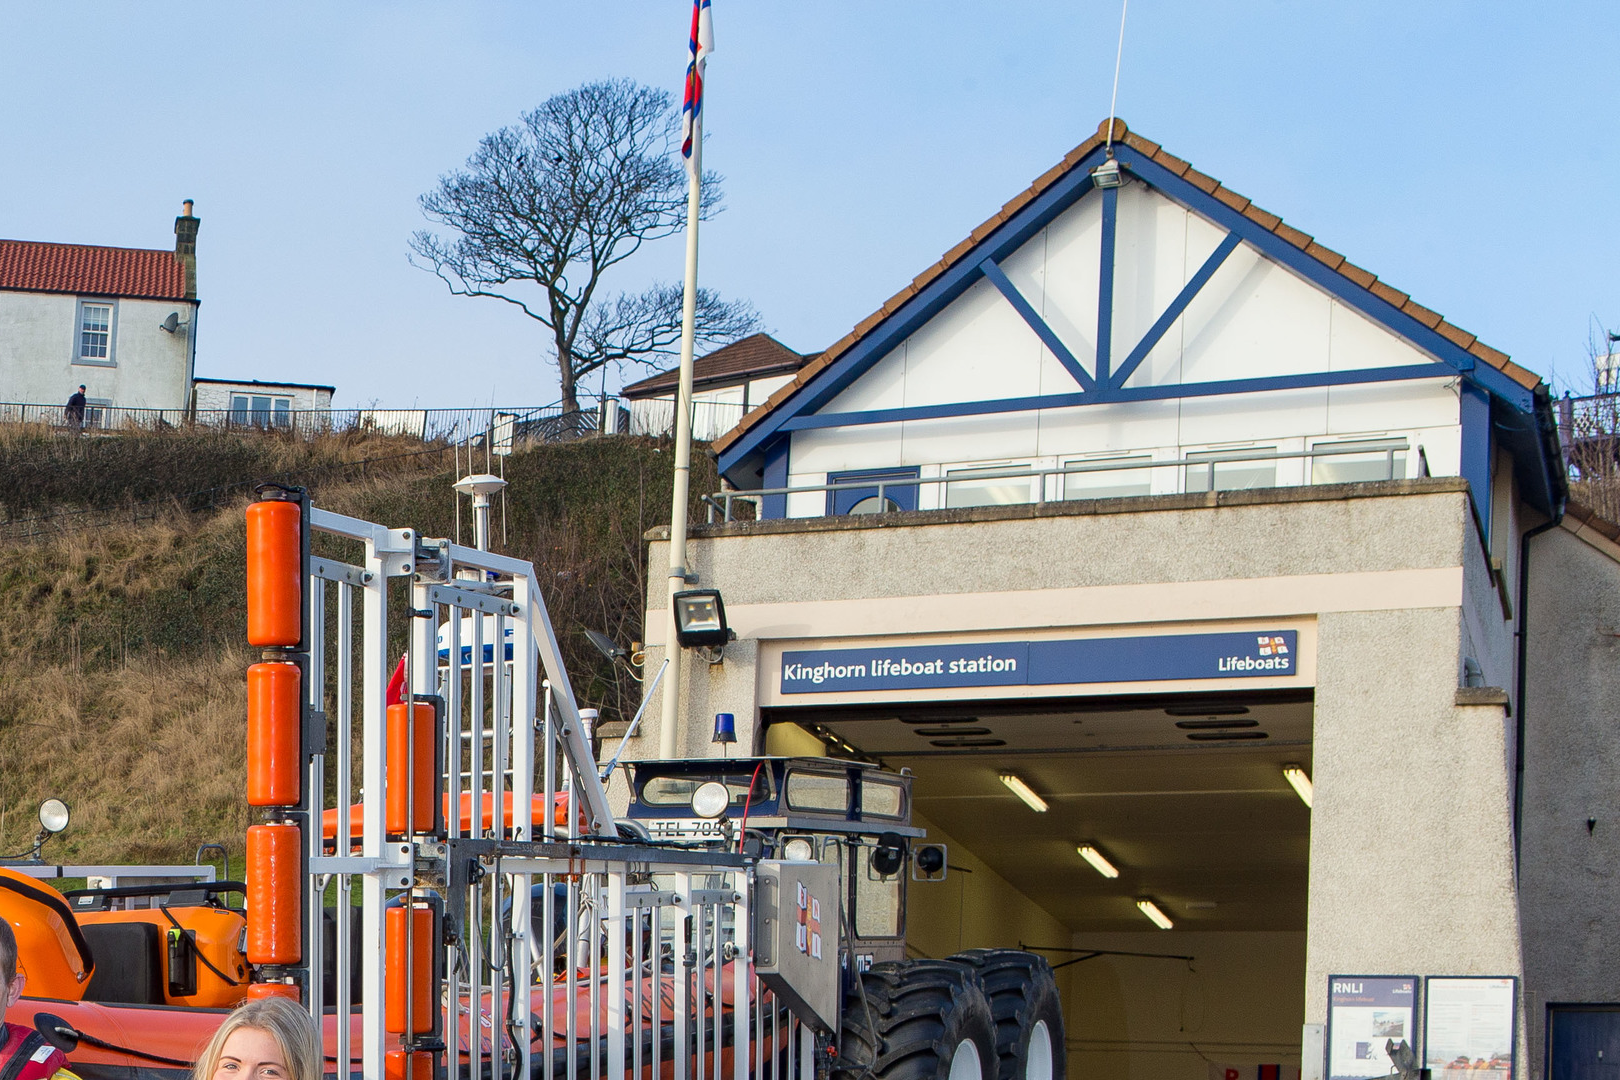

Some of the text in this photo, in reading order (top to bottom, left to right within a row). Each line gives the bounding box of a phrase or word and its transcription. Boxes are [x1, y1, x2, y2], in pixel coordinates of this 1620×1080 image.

[784, 655, 1016, 683] Kinghorn lifeboat station
[1218, 656, 1289, 671] Lifeboats
[655, 822, 686, 837] TEL
[1333, 983, 1363, 993] RNLI
